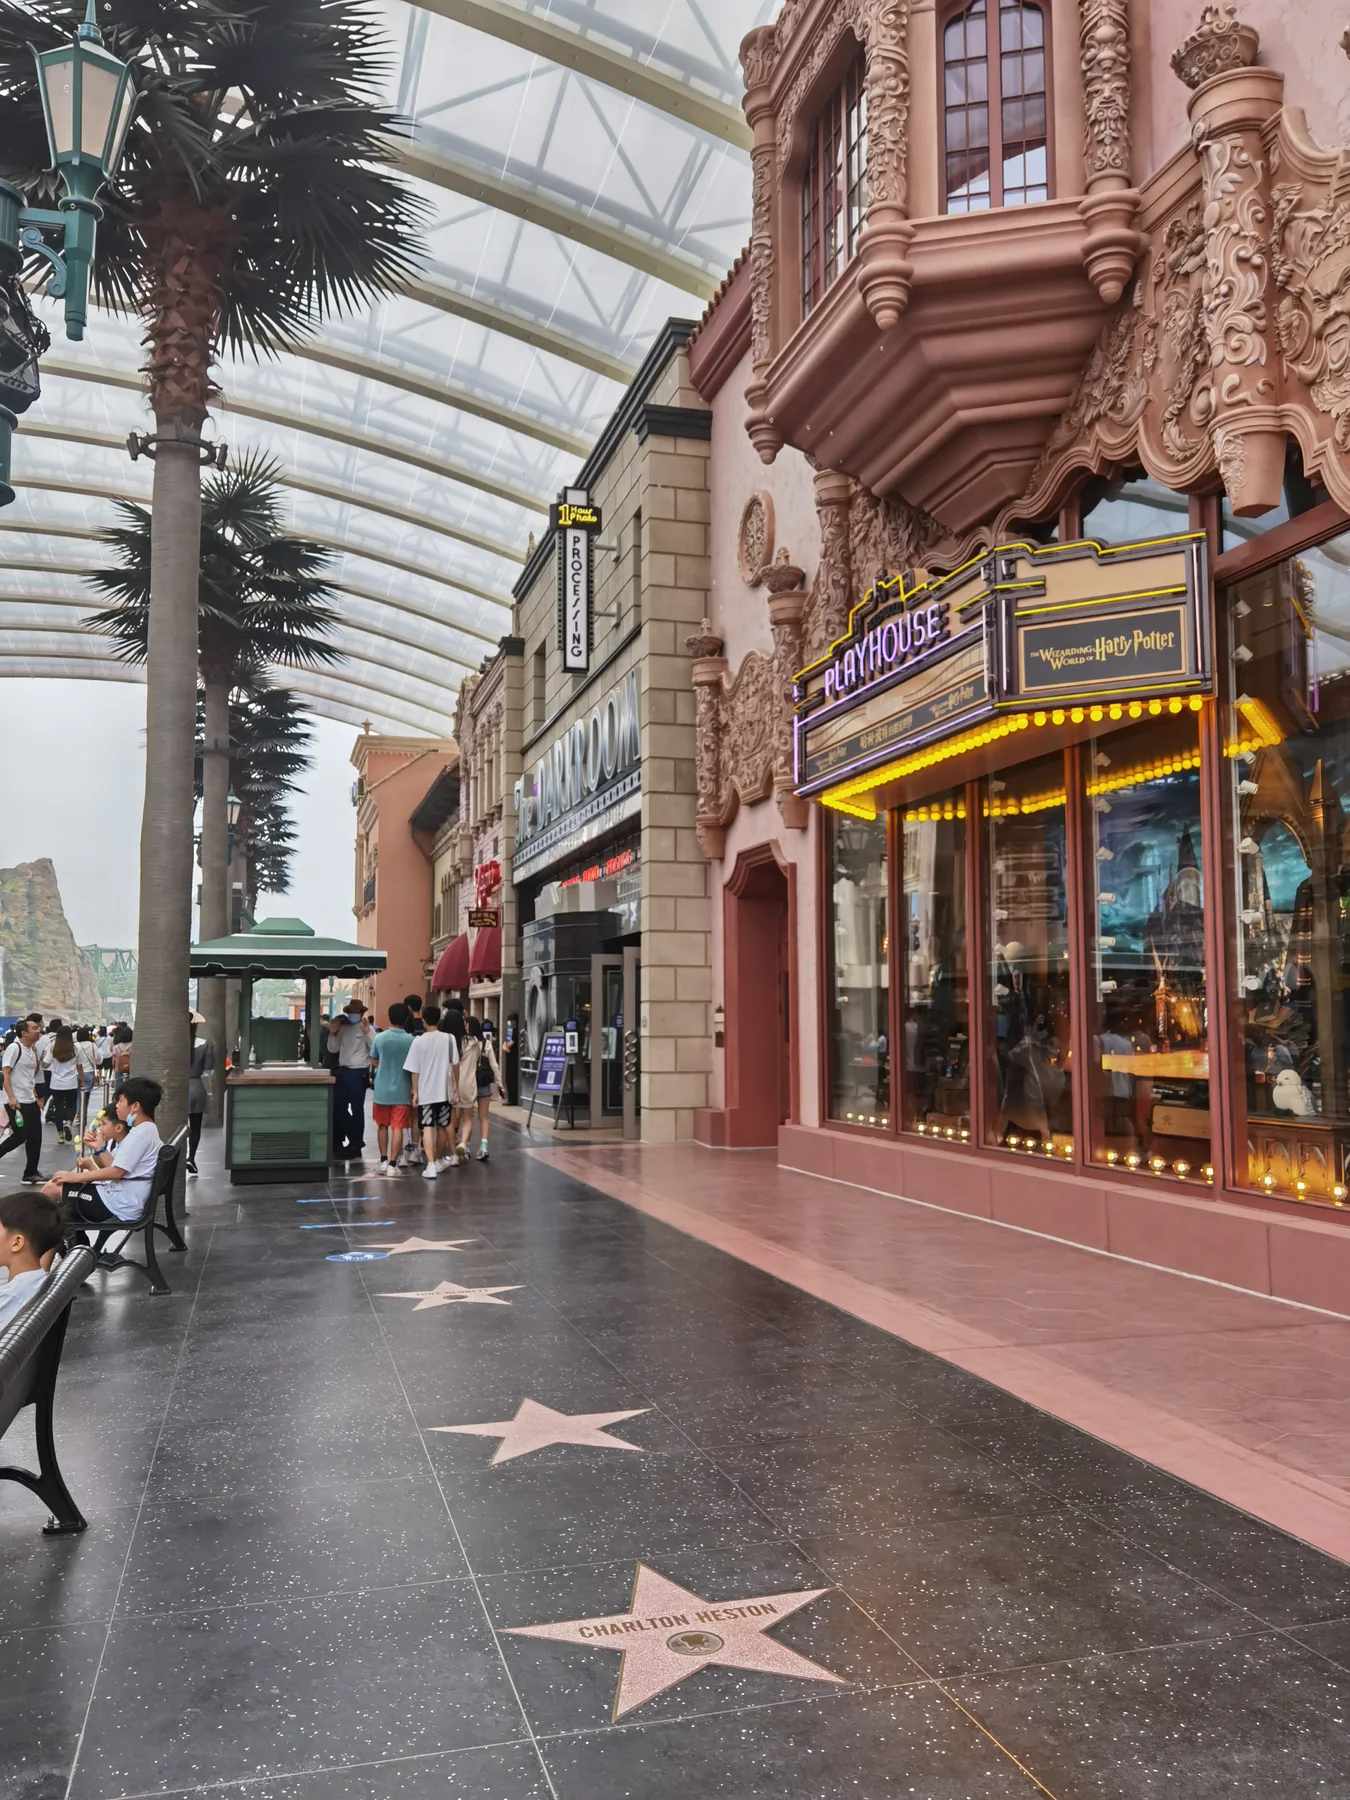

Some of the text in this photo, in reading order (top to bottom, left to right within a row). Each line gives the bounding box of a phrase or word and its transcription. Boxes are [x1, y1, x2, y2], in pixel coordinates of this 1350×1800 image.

[558, 504, 593, 525] 1 Hour
[569, 513, 597, 522] Photo
[571, 536, 582, 657] PROCESSING
[824, 603, 942, 697] PLAYHOUSE
[1039, 645, 1093, 662] WIZARDING
[1093, 629, 1175, 662] Harry Potter
[1050, 656, 1085, 671] WORLD
[514, 670, 641, 846] The DARKROOM
[578, 1603, 778, 1638] CHARLTON HESTON
